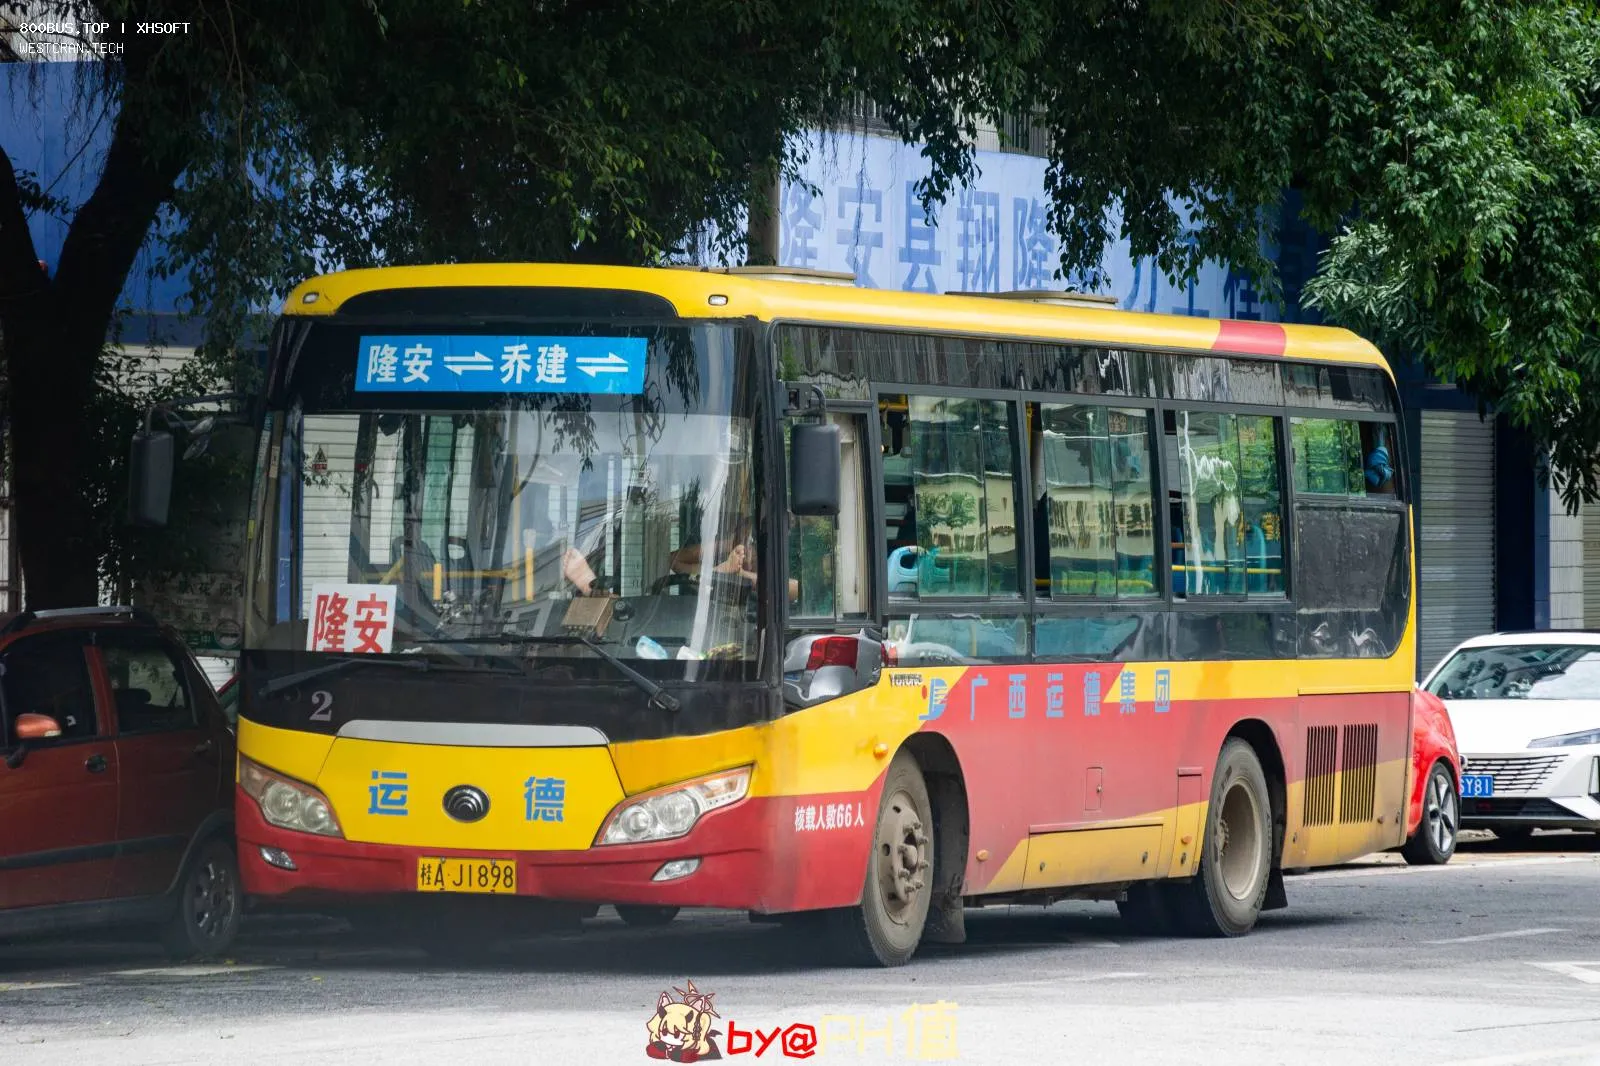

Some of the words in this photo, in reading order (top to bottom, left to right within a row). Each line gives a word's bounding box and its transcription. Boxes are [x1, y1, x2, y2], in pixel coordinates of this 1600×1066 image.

[366, 344, 433, 384] 隆安
[500, 344, 569, 384] 乔建
[311, 591, 388, 653] 隆安
[309, 690, 333, 721] 2
[969, 668, 1172, 721] 广西运德集团
[367, 770, 409, 816] 运
[523, 775, 567, 823] 德
[794, 801, 865, 833] 核载人数66人
